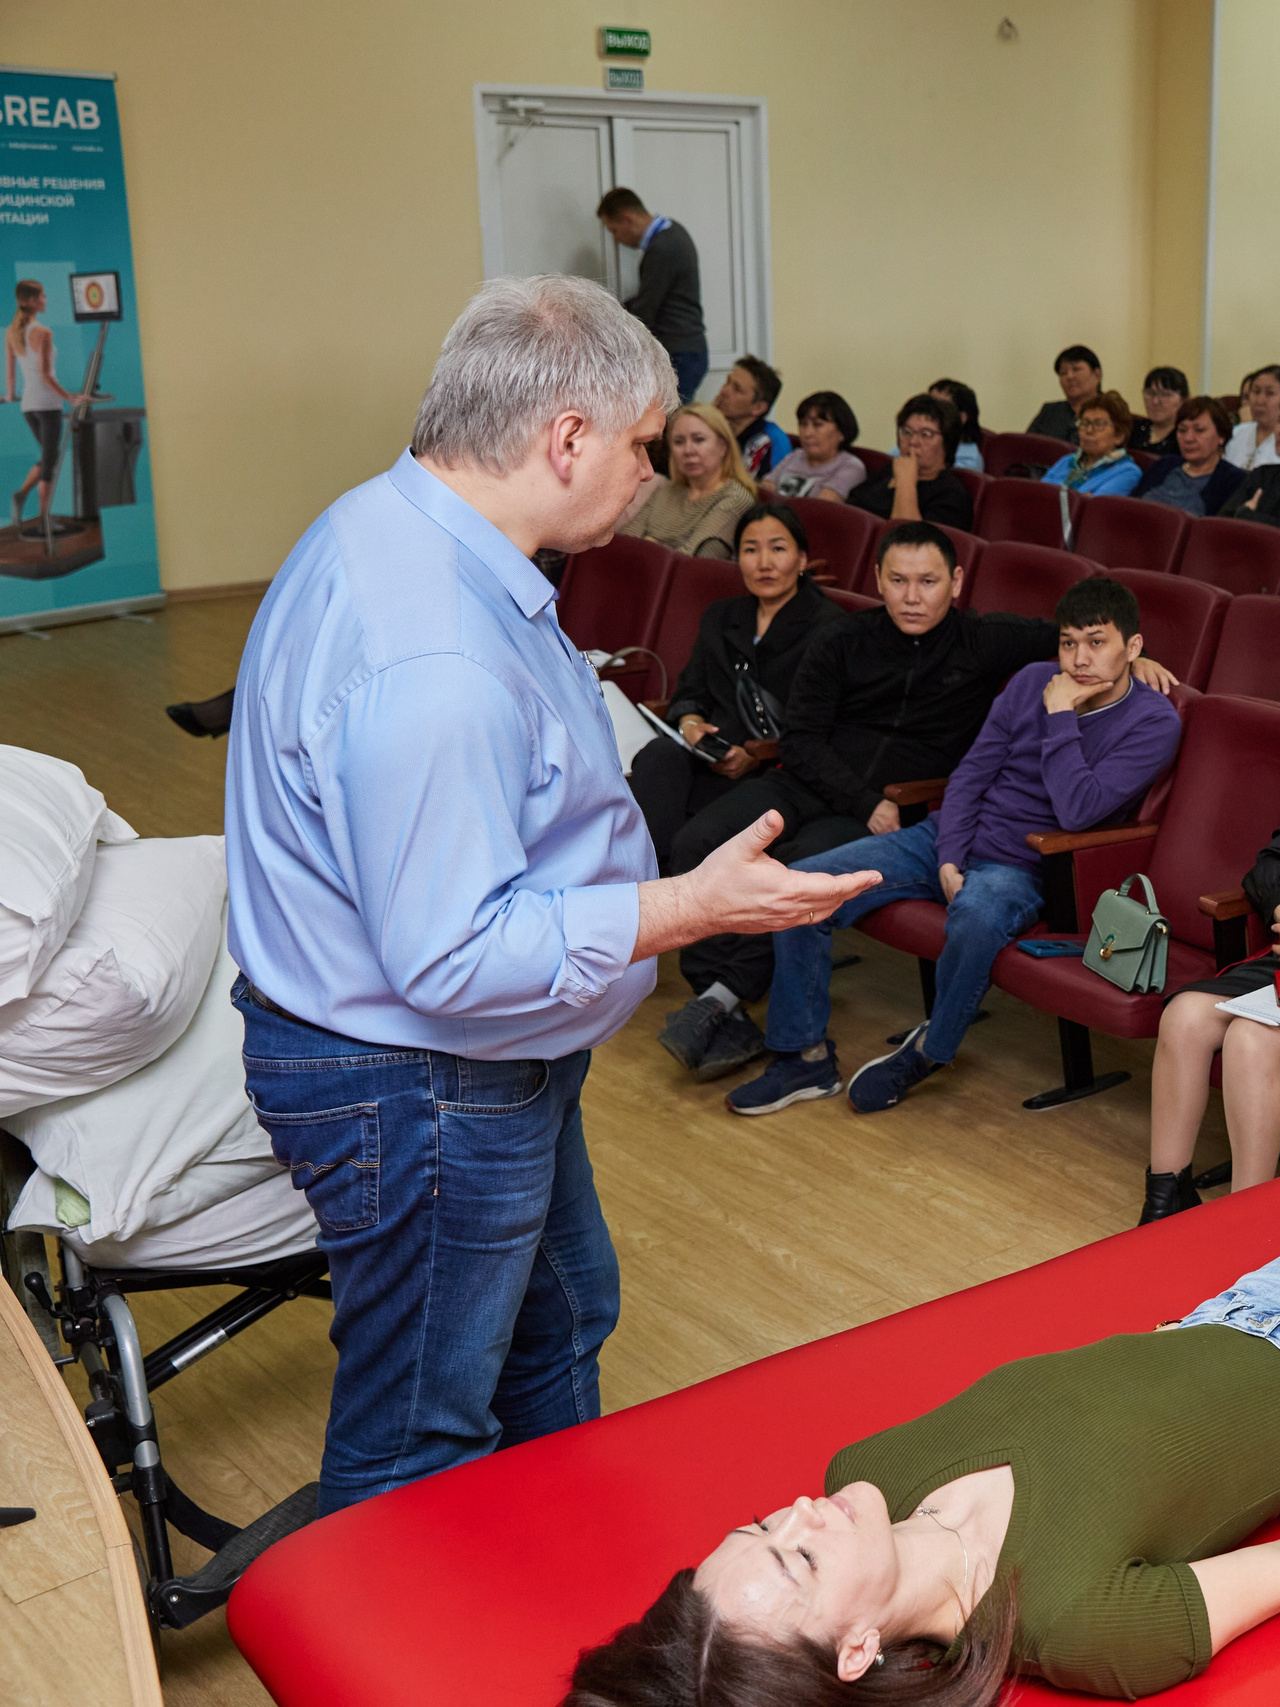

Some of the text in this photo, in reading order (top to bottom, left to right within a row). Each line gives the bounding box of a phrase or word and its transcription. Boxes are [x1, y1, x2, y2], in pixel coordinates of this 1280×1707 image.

[607, 32, 649, 51] ВЫХОД
[0, 94, 101, 130] REAB
[0, 175, 106, 191] ВНЫЕ РЕШЕНИЯ
